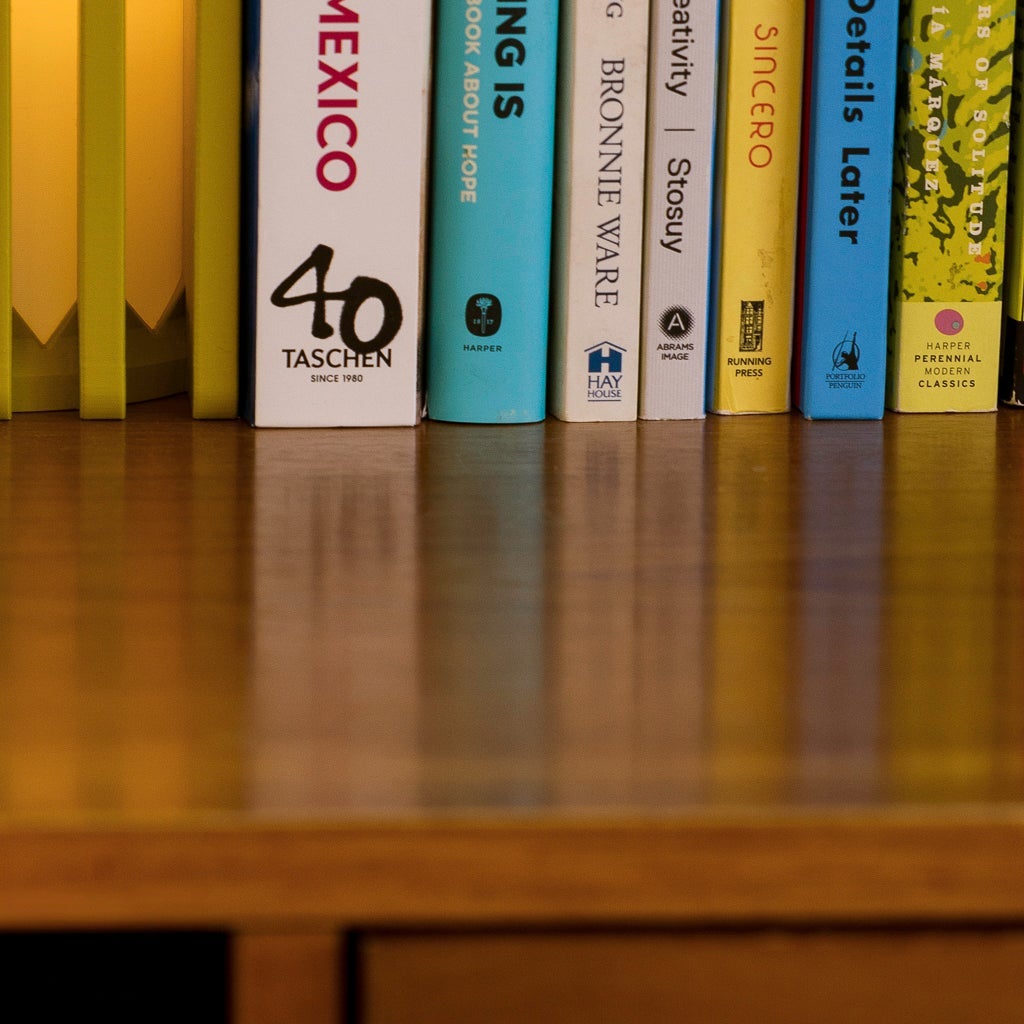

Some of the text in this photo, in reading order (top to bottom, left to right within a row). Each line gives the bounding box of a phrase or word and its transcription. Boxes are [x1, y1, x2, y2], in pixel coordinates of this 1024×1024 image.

[749, 24, 779, 168] SINCERO
[975, 57, 990, 90] OF
[463, 62, 480, 137] ABOUT
[493, 83, 524, 119] IS
[924, 52, 945, 192] MÁRQUEZ
[461, 145, 477, 203] HOPE
[595, 58, 625, 307] BRONNIE WARE
[839, 148, 868, 244] Later
[969, 109, 988, 256] SOLITUDE
[660, 158, 691, 253] Stosuy
[270, 244, 403, 355] 40
[282, 349, 392, 369] TASCHEN
[463, 344, 502, 352] HARPER
[728, 357, 772, 365] RUNNING
[927, 342, 970, 350] HARPER
[588, 375, 622, 388] HAY
[588, 390, 621, 398] HOUSE
[925, 367, 970, 375] MODERN
